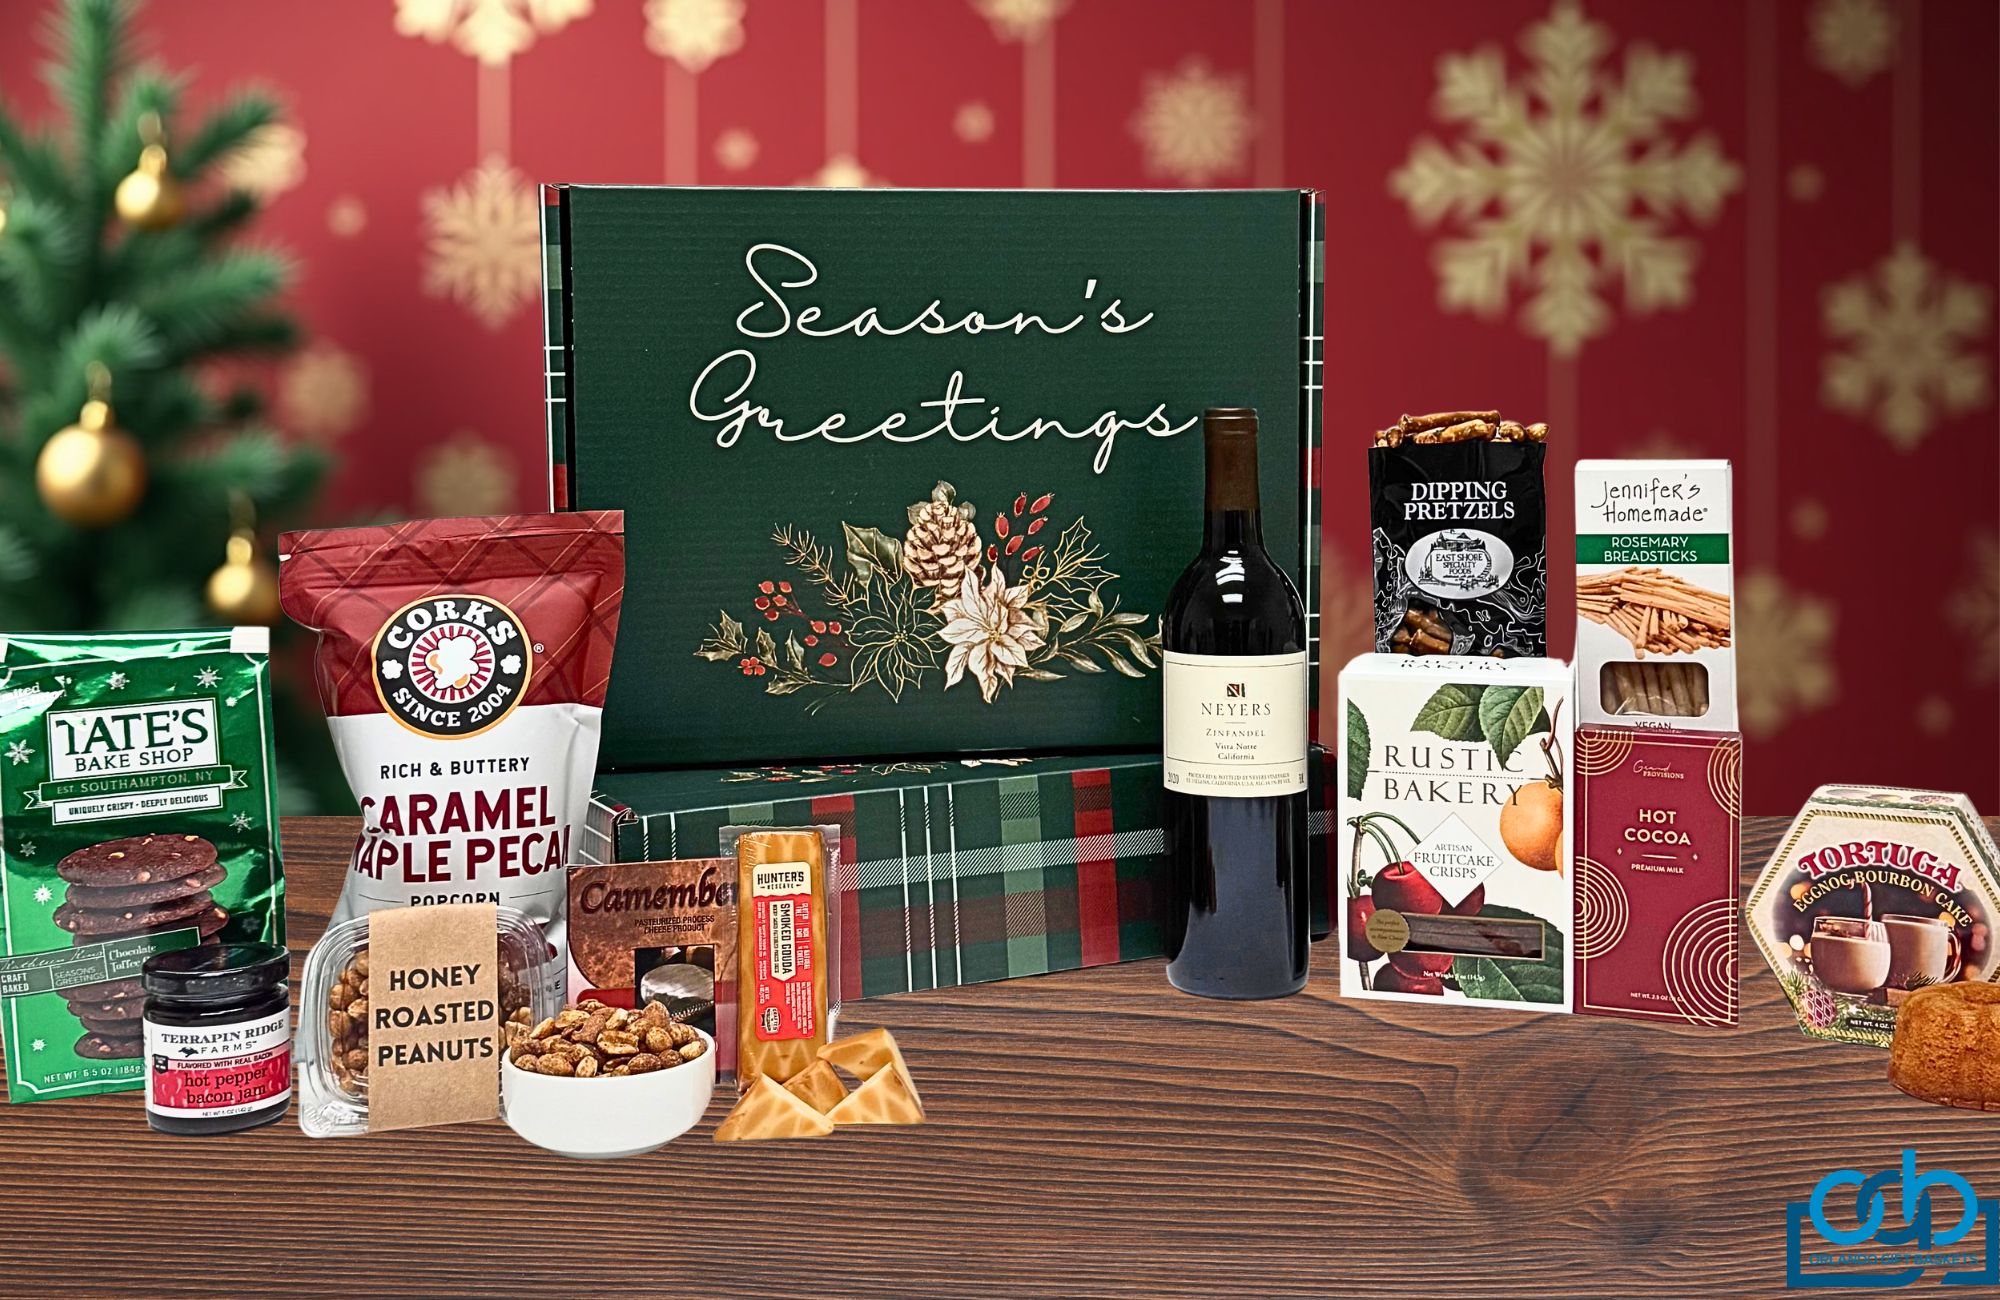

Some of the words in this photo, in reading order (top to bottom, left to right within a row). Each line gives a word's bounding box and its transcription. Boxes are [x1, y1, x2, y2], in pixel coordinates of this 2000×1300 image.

[735, 242, 1155, 339] Season's
[688, 348, 1200, 475] Greetings
[1411, 481, 1507, 500] DIPPING
[1404, 501, 1515, 520] PRETZELS
[1611, 536, 1689, 548] ROSEMARY
[1436, 553, 1456, 561] EAST
[1457, 553, 1483, 561] SHORE
[1604, 550, 1698, 562] BREADSTICKS
[387, 600, 518, 649] CORKS
[392, 687, 461, 727] SINCE
[467, 683, 513, 724] 2004
[1201, 702, 1272, 716] NEYERS
[1206, 728, 1266, 737] ZINFANDEL
[1635, 721, 1671, 729] VEGAN
[1215, 742, 1234, 750] Vista
[75, 753, 131, 773] BAKE
[139, 748, 194, 766] SHOP
[1217, 752, 1255, 760] California
[195, 770, 214, 782] NY
[381, 762, 422, 779] RICH
[430, 762, 443, 776] &
[451, 757, 530, 775] BUTTERY
[1384, 778, 1523, 806] BAKERY
[69, 804, 105, 815] UNIQUELY
[107, 802, 134, 812] CRISPY
[141, 798, 167, 808] DEEPLY
[170, 794, 208, 805] DELICIOUS
[361, 785, 556, 837] CARAMEL
[1639, 809, 1677, 824] HOT
[1624, 828, 1691, 846] COCOA
[1434, 843, 1472, 852] ARTISAN
[1414, 852, 1494, 867] FRUITCAKE
[1799, 840, 1963, 893] TORTUGA
[1430, 866, 1477, 879] CRISPS
[1631, 863, 1665, 873] PREMIUM
[1667, 866, 1684, 874] MILK
[757, 871, 804, 885] HUNTER'S
[1793, 873, 1856, 913] EGGNOG
[1855, 870, 1934, 897] BOURBON
[1935, 892, 1973, 928] CAKE
[635, 917, 680, 926] PASTEURIZED
[683, 915, 715, 924] PROCESS
[781, 903, 791, 941] SMOKED
[644, 926, 671, 934] CHEESE
[673, 924, 705, 932] PRODUCT
[109, 945, 157, 960] Chocolate
[782, 944, 792, 974] GOUDA
[54, 966, 96, 979] SEASONS
[110, 959, 141, 972] Toffee
[1, 973, 27, 983] CRAFT
[55, 972, 105, 987] GREETINGS
[390, 964, 481, 991] HONEY
[2, 983, 29, 993] BAKED
[375, 1000, 494, 1030] ROASTED
[161, 1030, 241, 1044] TERRAPIN
[245, 1019, 284, 1038] RIDGE
[214, 1059, 233, 1068] WITH
[234, 1056, 252, 1065] REAL
[254, 1051, 273, 1061] BACON
[378, 1037, 493, 1067] PEANUTS
[44, 1073, 61, 1083] NET
[101, 1067, 112, 1076] OZ
[184, 1073, 210, 1087] hot
[216, 1067, 268, 1089] pepper
[186, 1090, 233, 1104] bacon
[238, 1083, 266, 1102] jam
